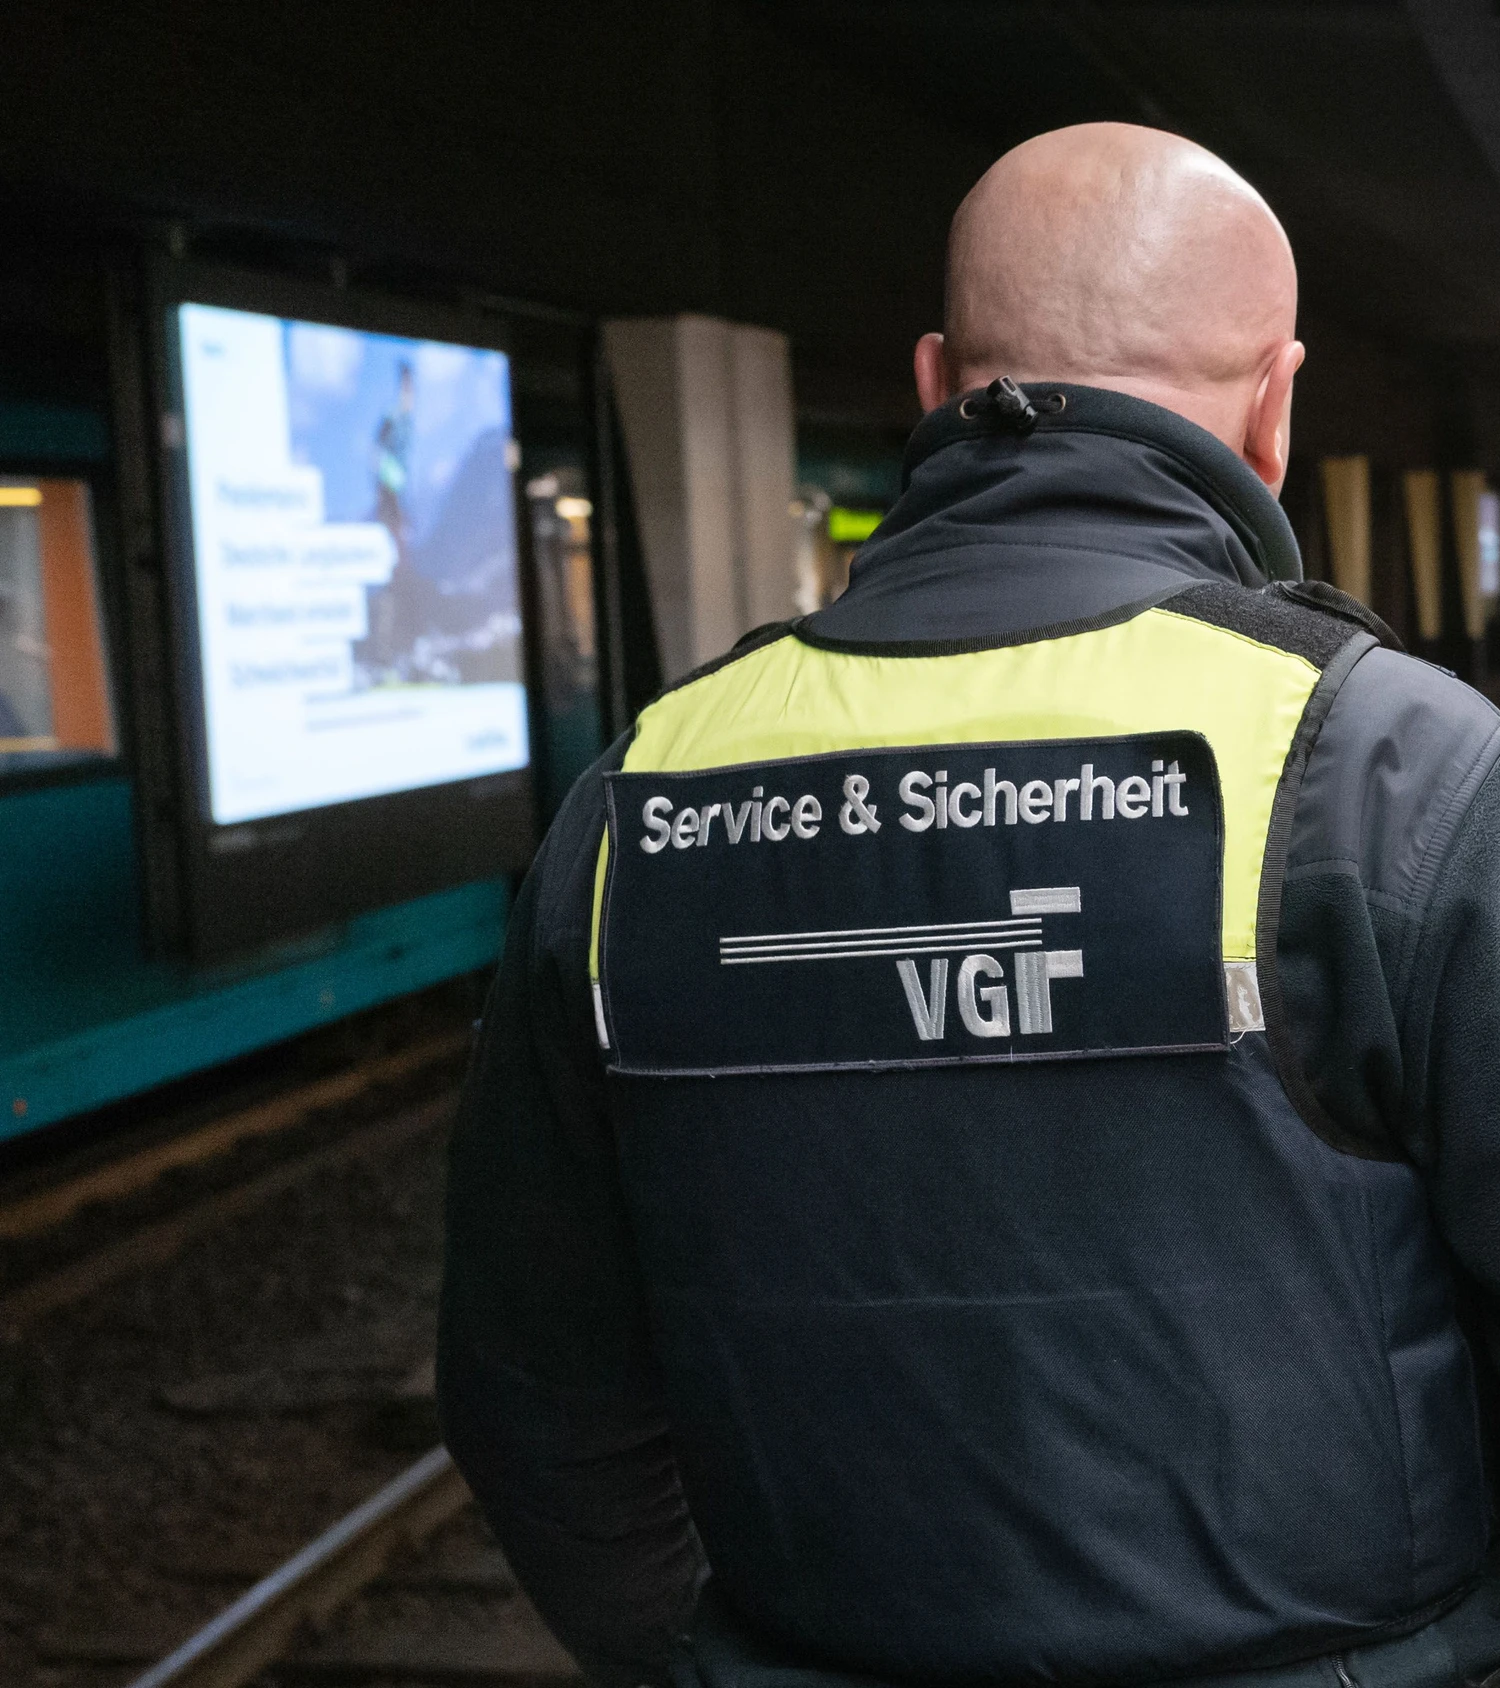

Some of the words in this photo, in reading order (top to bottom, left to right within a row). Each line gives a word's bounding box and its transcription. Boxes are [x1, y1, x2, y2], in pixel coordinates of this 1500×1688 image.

[639, 785, 822, 854] Service
[839, 774, 882, 835] &
[899, 759, 1189, 833] Sicherheit
[896, 886, 1084, 1041] VGF
